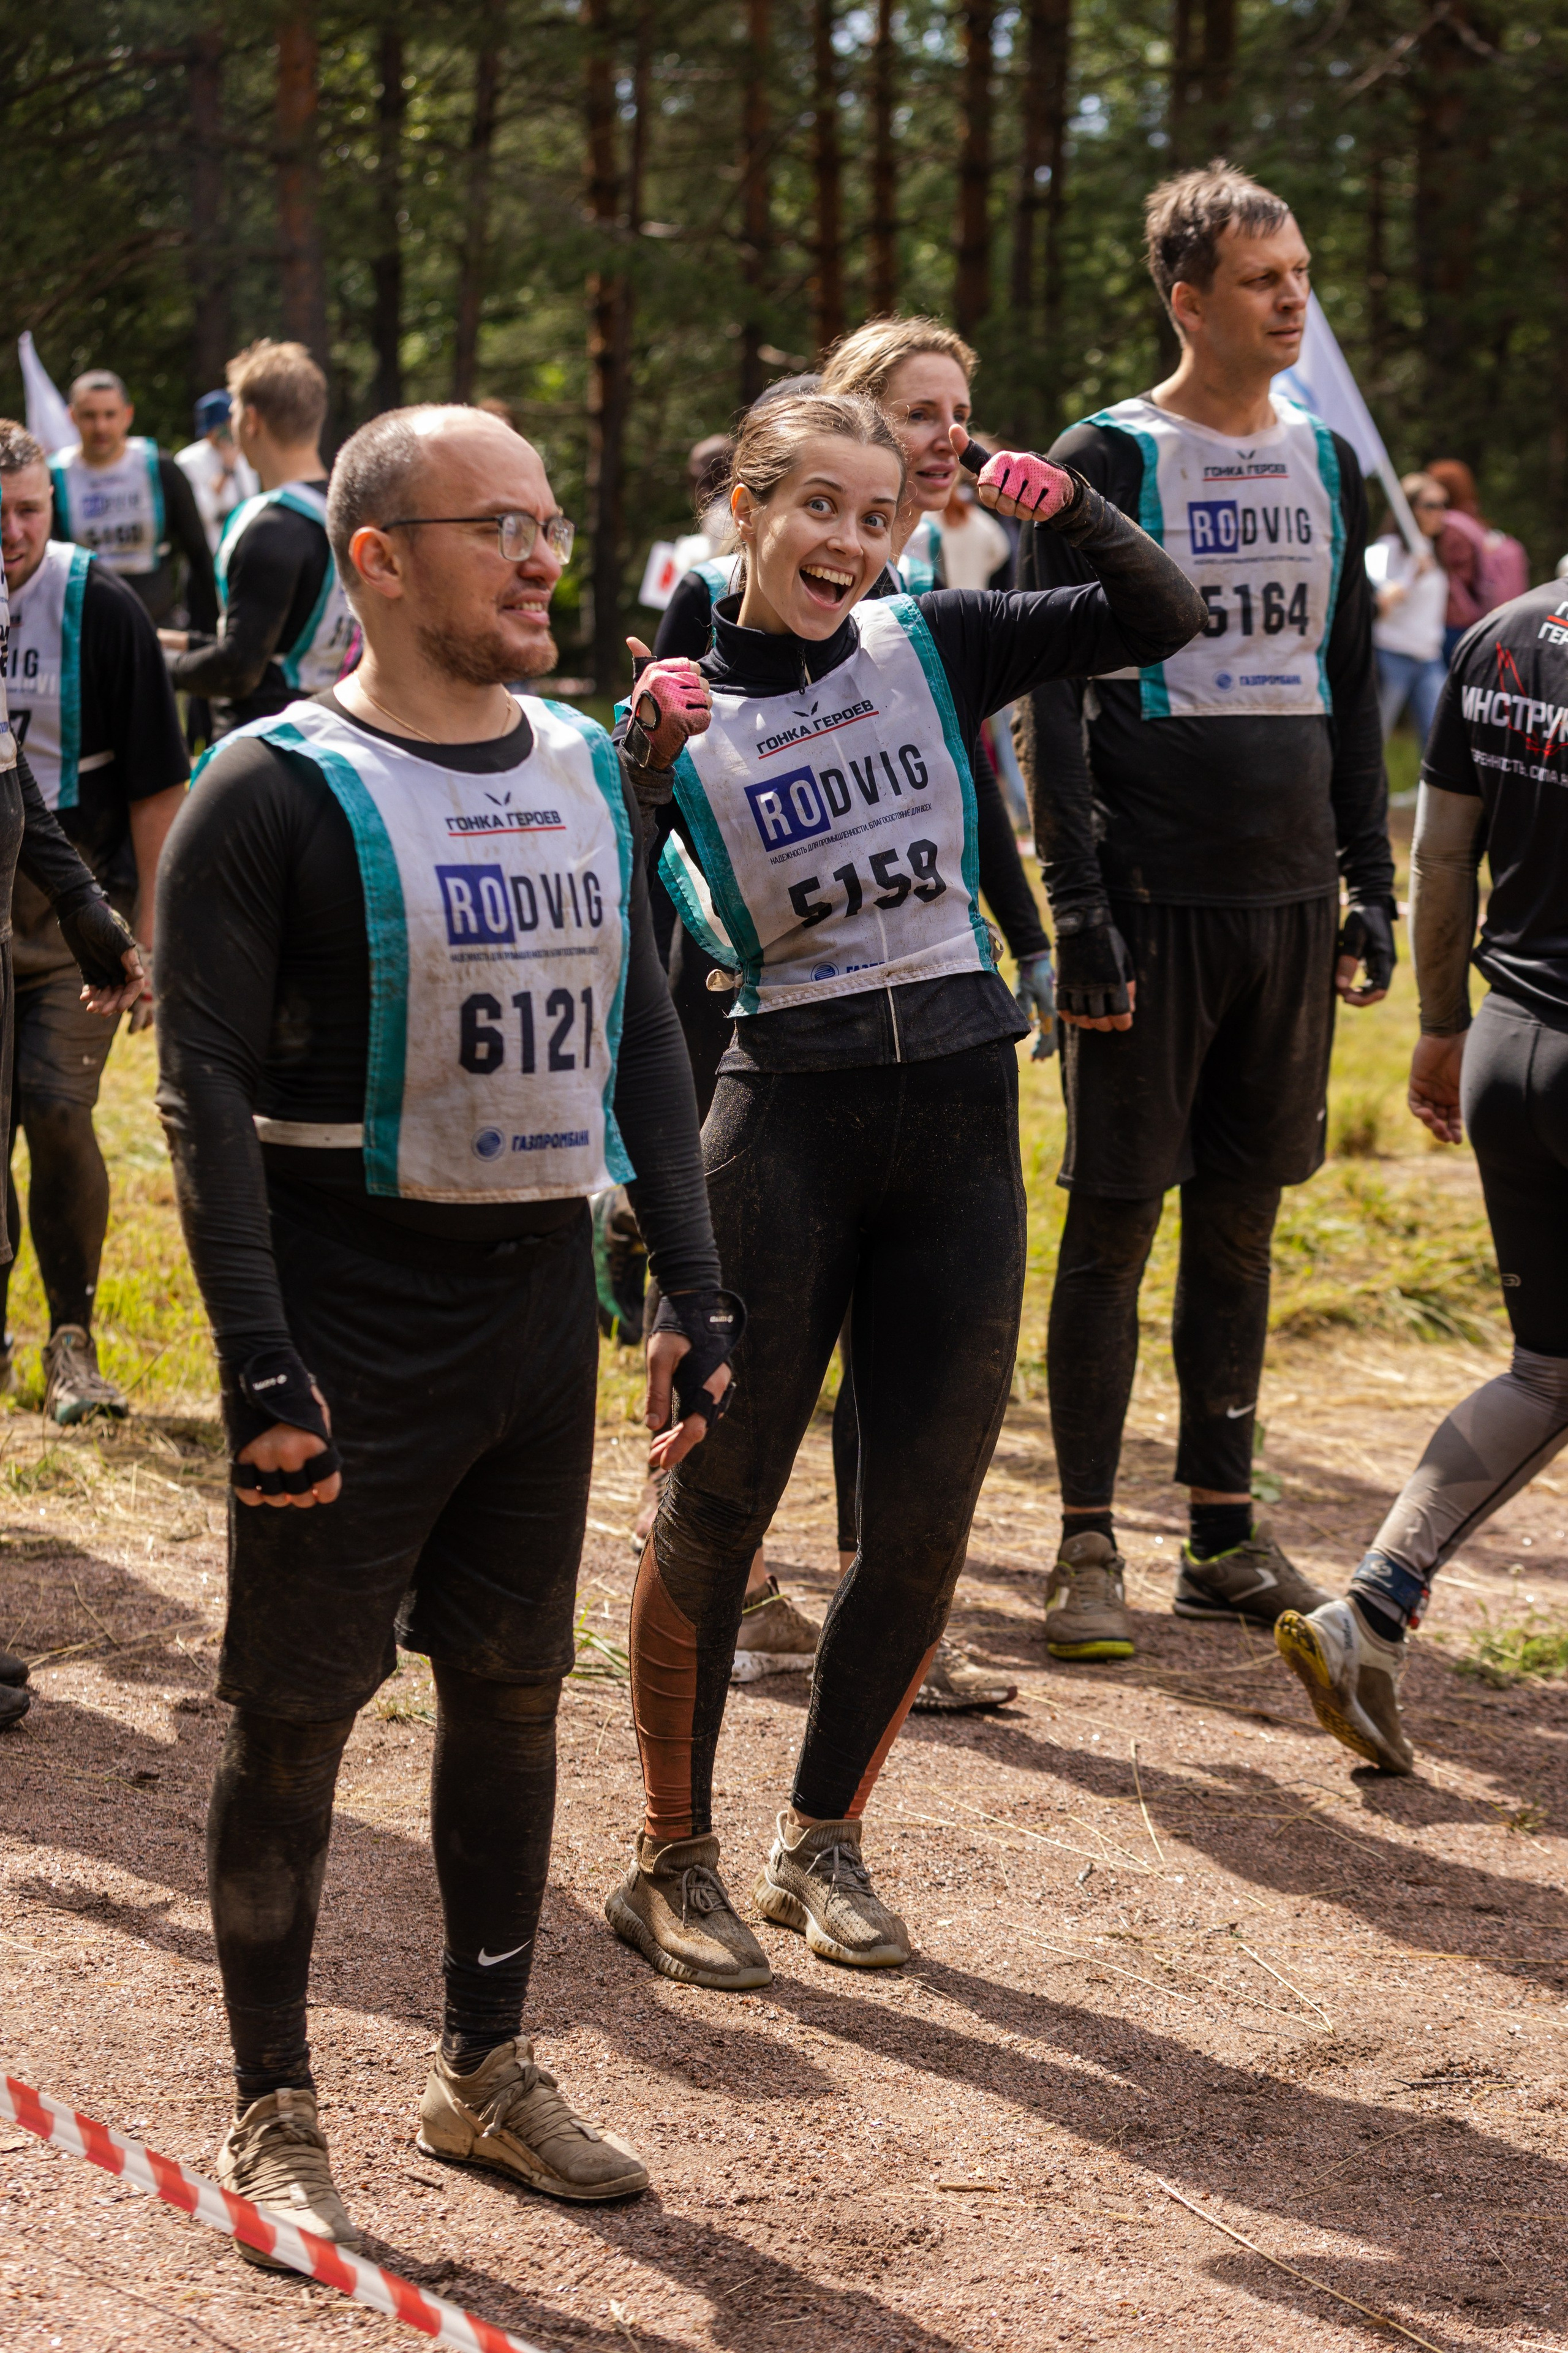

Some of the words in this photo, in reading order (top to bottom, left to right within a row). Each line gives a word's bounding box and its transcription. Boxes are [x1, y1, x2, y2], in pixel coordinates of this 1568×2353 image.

[1204, 466, 1244, 477] ГОНКА
[1192, 506, 1311, 548] RODVIG
[1200, 582, 1310, 638] 5164
[756, 724, 812, 755] ГОНКА
[812, 700, 875, 732] ГЕРОЕВ
[445, 815, 504, 831] ГОНКА
[506, 810, 562, 827] ГЕРОЕВ
[754, 744, 929, 842] RODVIG
[770, 848, 808, 865] НАДЕЖНОСТЬ
[808, 841, 820, 853] ДЛЯ
[869, 811, 911, 829] БЛАГОСОСТОЯНИЕ
[920, 803, 932, 814] ВСЕХ
[444, 871, 603, 935] RODVIG
[788, 839, 947, 929] 5159
[459, 986, 594, 1075] 6121
[512, 1130, 590, 1152] ГАЗПРОМБАНК
